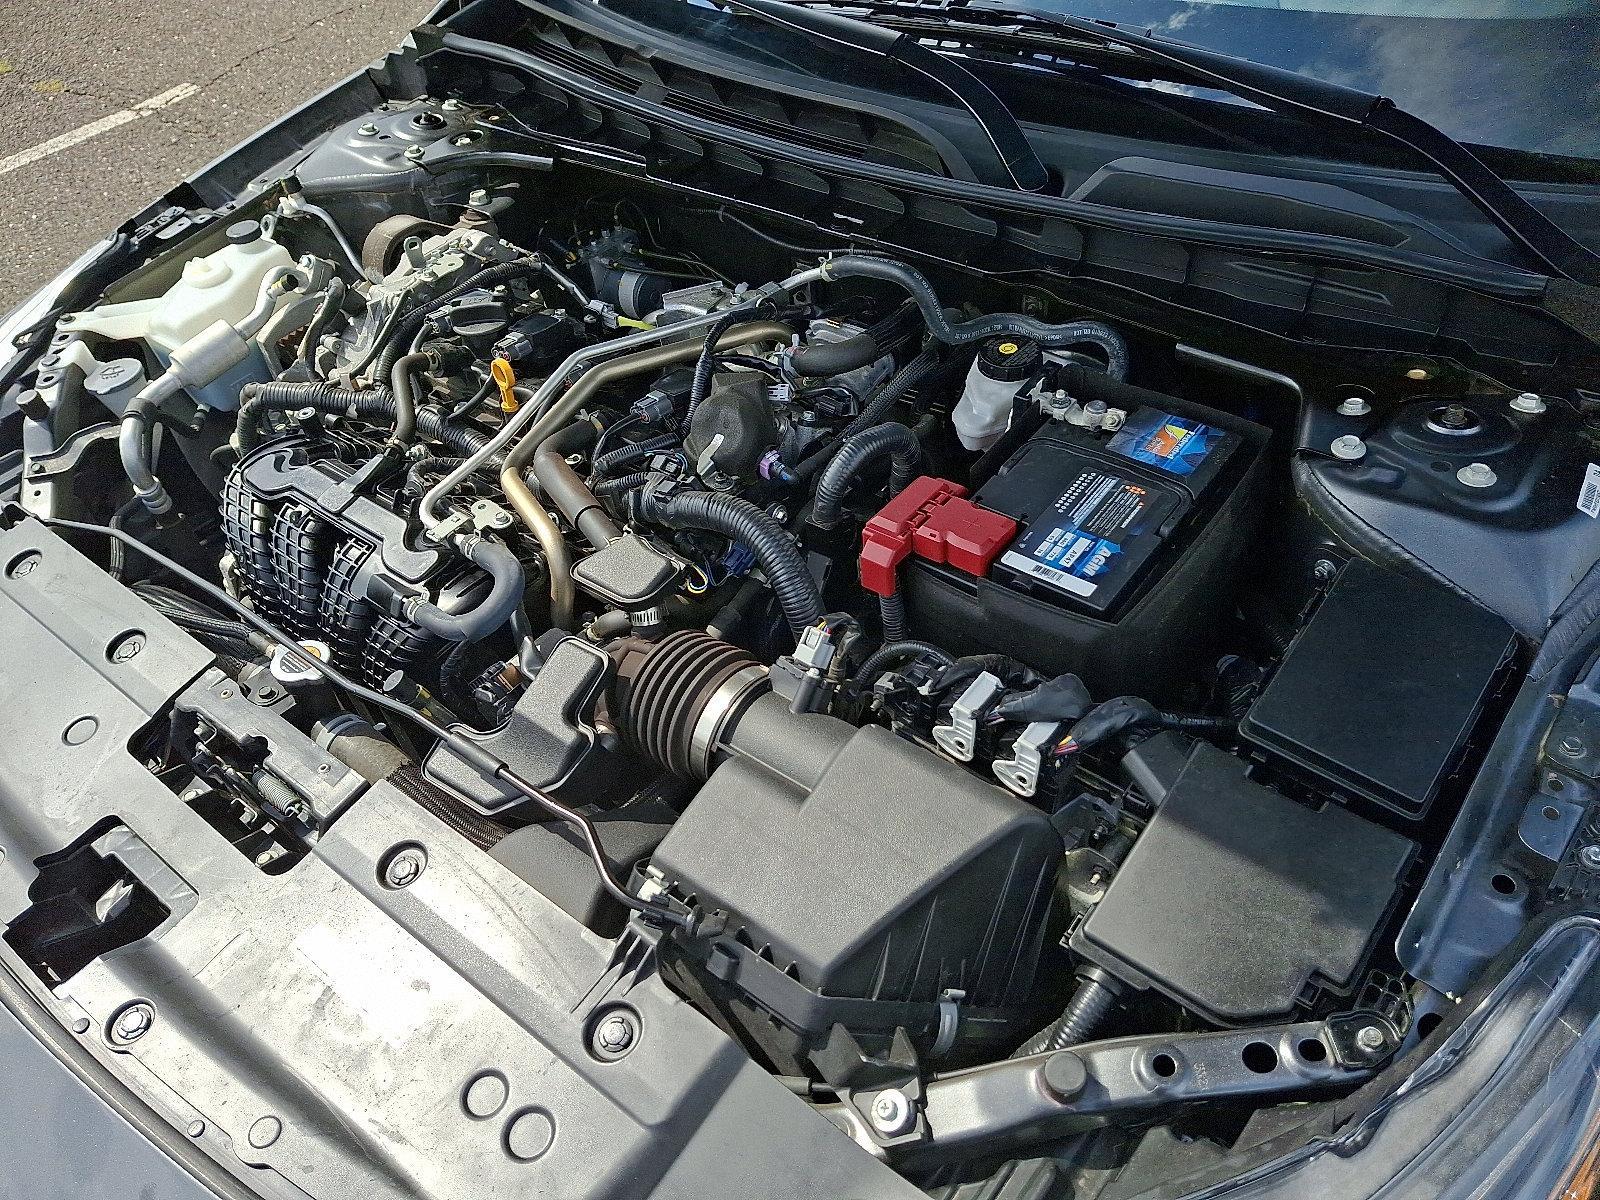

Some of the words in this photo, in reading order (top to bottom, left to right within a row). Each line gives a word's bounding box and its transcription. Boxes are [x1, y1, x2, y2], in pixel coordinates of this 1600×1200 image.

[1166, 430, 1195, 460] Federated
[1063, 549, 1078, 565] AP47
[1083, 545, 1112, 577] AGM
